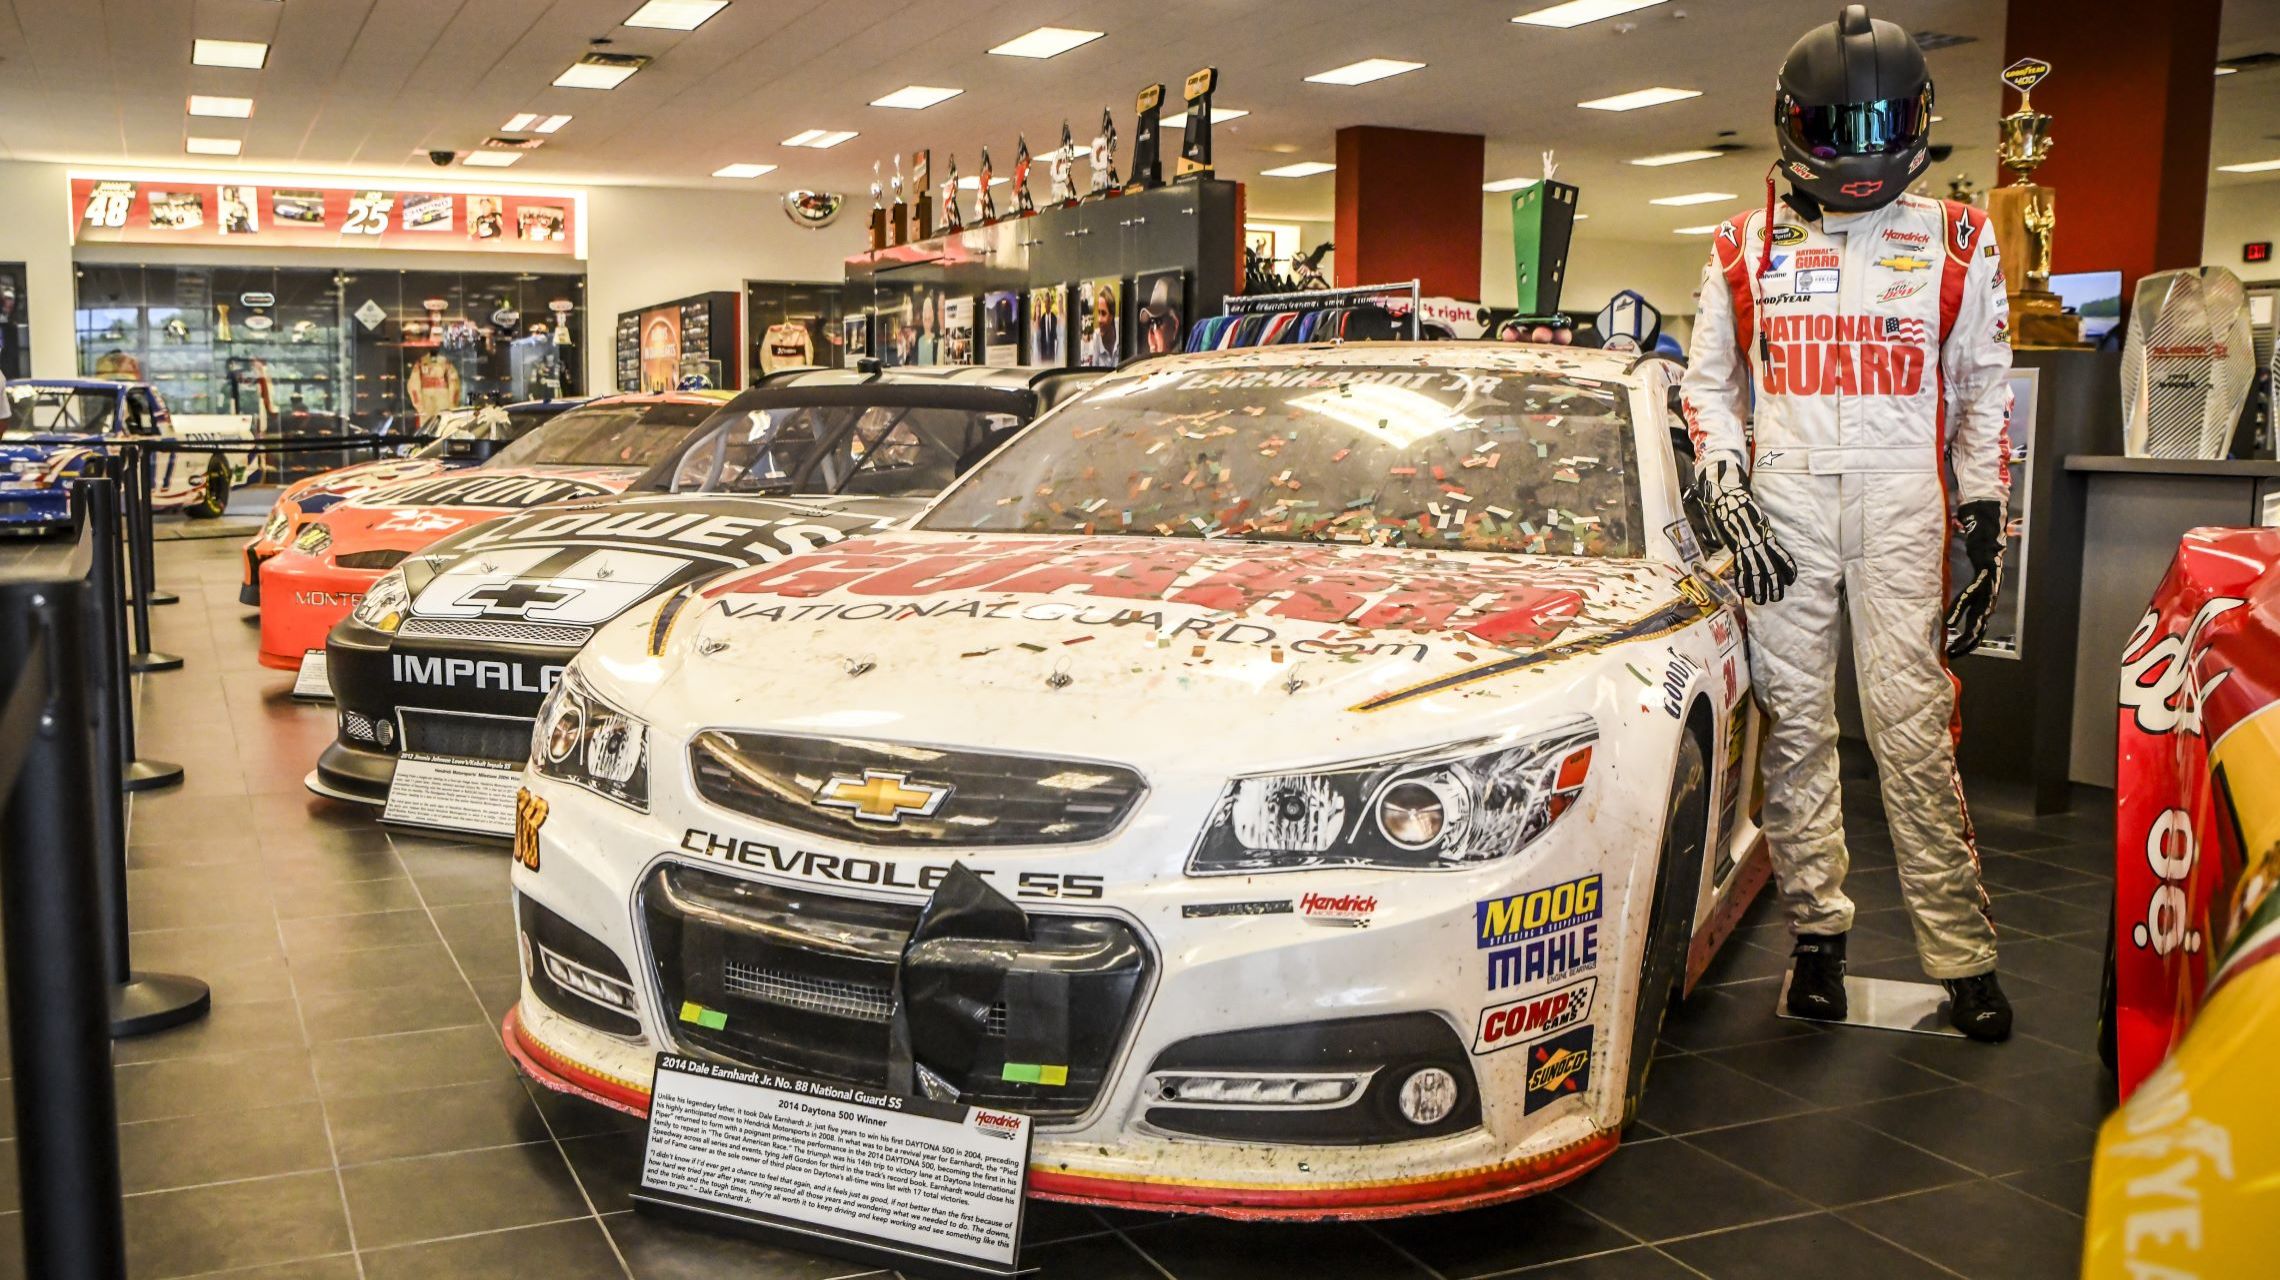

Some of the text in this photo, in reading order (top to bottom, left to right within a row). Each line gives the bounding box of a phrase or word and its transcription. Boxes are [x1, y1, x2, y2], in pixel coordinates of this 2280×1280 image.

[2014, 74, 2037, 86] 400
[84, 195, 131, 228] 48
[340, 199, 394, 235] 25
[1796, 248, 1828, 256] NATIONAL
[1882, 229, 1930, 243] Hendrick
[1796, 255, 1839, 269] GUARD
[1438, 306, 1475, 322] right.
[1762, 315, 1886, 342] NATIONAL
[1178, 370, 1443, 391] EARNHARDT
[1762, 343, 1925, 396] GUARD
[455, 512, 848, 567] LOWE'S
[296, 591, 364, 607] MONTE
[680, 828, 1105, 900] CHEVROLE SS
[1300, 893, 1378, 916] Hendrick
[1482, 876, 1599, 939] MOOG
[1490, 929, 1535, 946] STEERING
[1548, 912, 1594, 932] SUSPENSION
[1488, 924, 1598, 991] MAHLE
[1547, 963, 1597, 984] ENGINE BEARINGS
[1484, 992, 1570, 1043] COMP
[1542, 1010, 1577, 1032] CAMS
[662, 1056, 902, 1109] 2014 Dale Earnhardt Jr. No. 88 National Guard SS
[1531, 1053, 1584, 1090] SUNOCO
[657, 1092, 675, 1102] Unlike
[676, 1095, 685, 1104] his
[686, 1097, 716, 1110] legendary
[716, 1103, 735, 1114] father,
[743, 1109, 757, 1117] took
[758, 1111, 773, 1120] Dale
[773, 1114, 804, 1126] Earnhardt
[813, 1122, 826, 1131] just
[827, 1124, 839, 1133] five
[839, 1128, 857, 1136] years
[867, 1132, 878, 1140] win
[879, 1133, 889, 1142] his
[890, 1135, 904, 1145] first
[904, 1138, 939, 1152] DAYTONA
[941, 1145, 955, 1155] 500
[955, 1148, 962, 1156] in
[963, 1149, 982, 1161] 2004,
[984, 1155, 1019, 1167] preceding
[777, 1099, 887, 1127] 2014 Daytona 500 Winner
[975, 1110, 1022, 1130] Hendrick
[656, 1100, 664, 1108] his
[665, 1102, 683, 1113] highly
[683, 1107, 717, 1119] anticipated
[717, 1114, 734, 1122] move
[735, 1116, 742, 1124] to
[743, 1117, 770, 1129] Hendrick
[771, 1122, 810, 1137] Motorsports
[810, 1130, 817, 1138] in
[818, 1131, 834, 1141] 2008.
[837, 1135, 843, 1143] In
[844, 1138, 861, 1146] what
[875, 1143, 883, 1151] to
[884, 1144, 893, 1152] be
[899, 1149, 921, 1158] revival
[921, 1153, 937, 1161] year
[938, 1154, 948, 1163] for
[949, 1156, 984, 1170] Earnhardt,
[985, 1163, 997, 1172] the
[674, 1114, 700, 1124] returned
[709, 1119, 723, 1128] form
[724, 1123, 737, 1131] with
[743, 1128, 771, 1138] poignant
[771, 1133, 805, 1145] prime-time
[806, 1140, 846, 1153] performance
[847, 1146, 854, 1154] in
[855, 1148, 866, 1156] the
[867, 1150, 884, 1160] 2014
[885, 1153, 919, 1167] DAYTONA
[921, 1160, 935, 1171] 500,
[937, 1164, 970, 1178] becoming
[971, 1170, 983, 1179] the
[984, 1172, 998, 1182] first
[999, 1175, 1006, 1183] in
[1006, 1177, 1017, 1186] his
[653, 1117, 671, 1128] family
[680, 1124, 699, 1134] repeat
[723, 1131, 741, 1141] Great
[741, 1135, 770, 1147] American
[793, 1145, 805, 1154] The
[806, 1148, 831, 1159] triumph
[832, 1154, 845, 1162] was
[846, 1155, 855, 1164] his
[857, 1157, 871, 1167] 14th
[873, 1162, 885, 1170] trip
[895, 1166, 917, 1176] victory
[918, 1169, 933, 1179] lane
[942, 1174, 971, 1187] Daytona
[972, 1180, 1016, 1195] International
